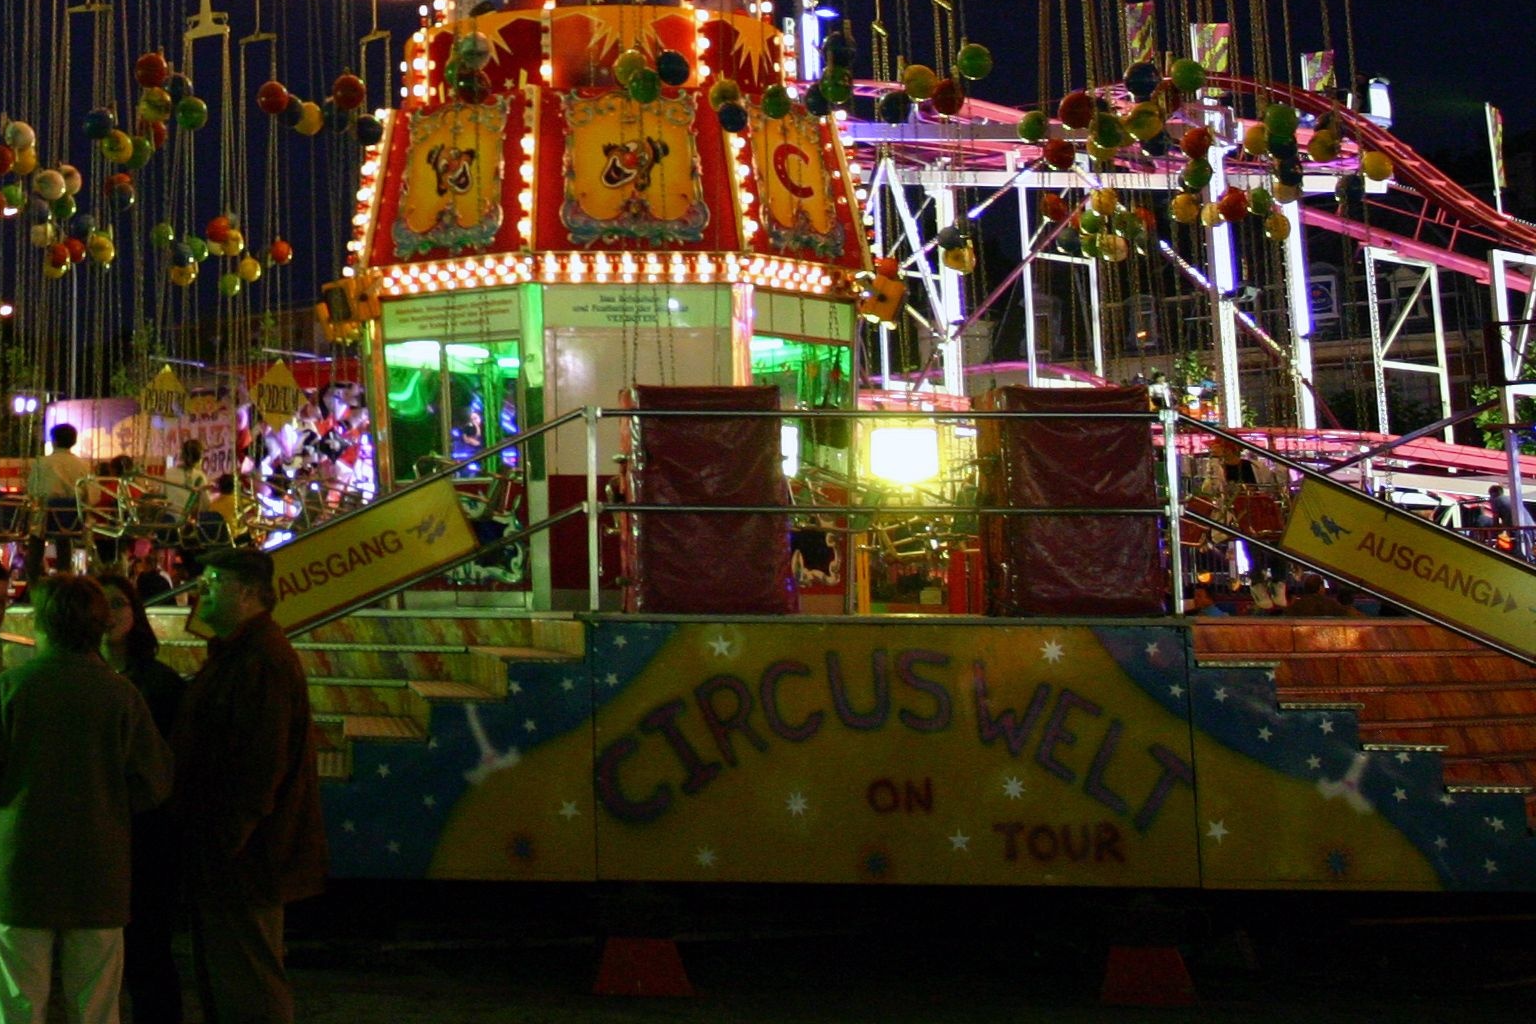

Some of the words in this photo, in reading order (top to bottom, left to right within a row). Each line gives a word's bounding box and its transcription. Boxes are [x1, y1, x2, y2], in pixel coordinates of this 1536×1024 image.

[278, 529, 404, 600] AUSGANG
[1355, 532, 1494, 606] AUSGANG
[595, 648, 952, 824] CIRCUS
[973, 659, 1197, 834] WELT
[866, 777, 935, 815] ON
[993, 822, 1127, 864] TOUR
